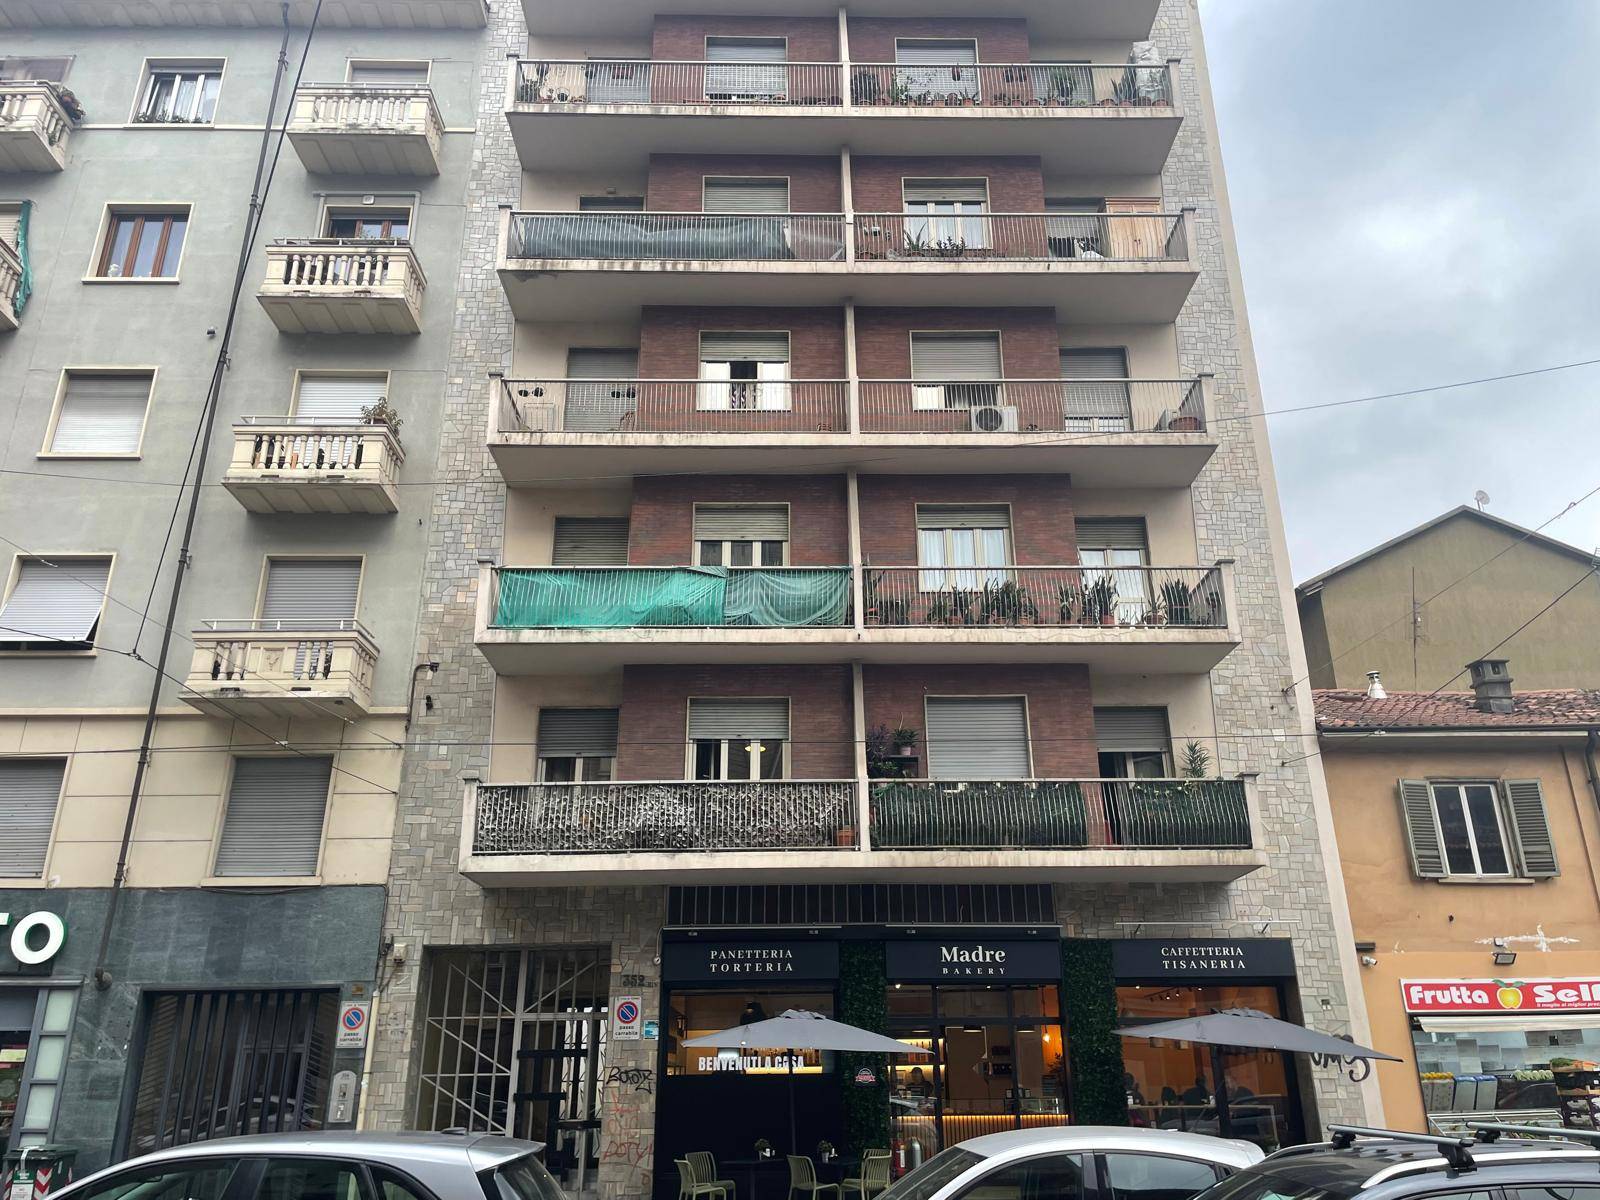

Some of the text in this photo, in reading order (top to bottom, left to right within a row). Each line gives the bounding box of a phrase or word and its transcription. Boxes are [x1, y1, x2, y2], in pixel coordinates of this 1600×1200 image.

[710, 949, 793, 960] PANETTERIA
[940, 945, 1006, 963] Madre
[1161, 947, 1244, 956] CAFFETTERIA
[710, 962, 793, 973] TORTERIA
[1162, 960, 1246, 969] TISANERIA
[942, 967, 1005, 975] BAKERY
[698, 1056, 761, 1071] BENVENUTI
